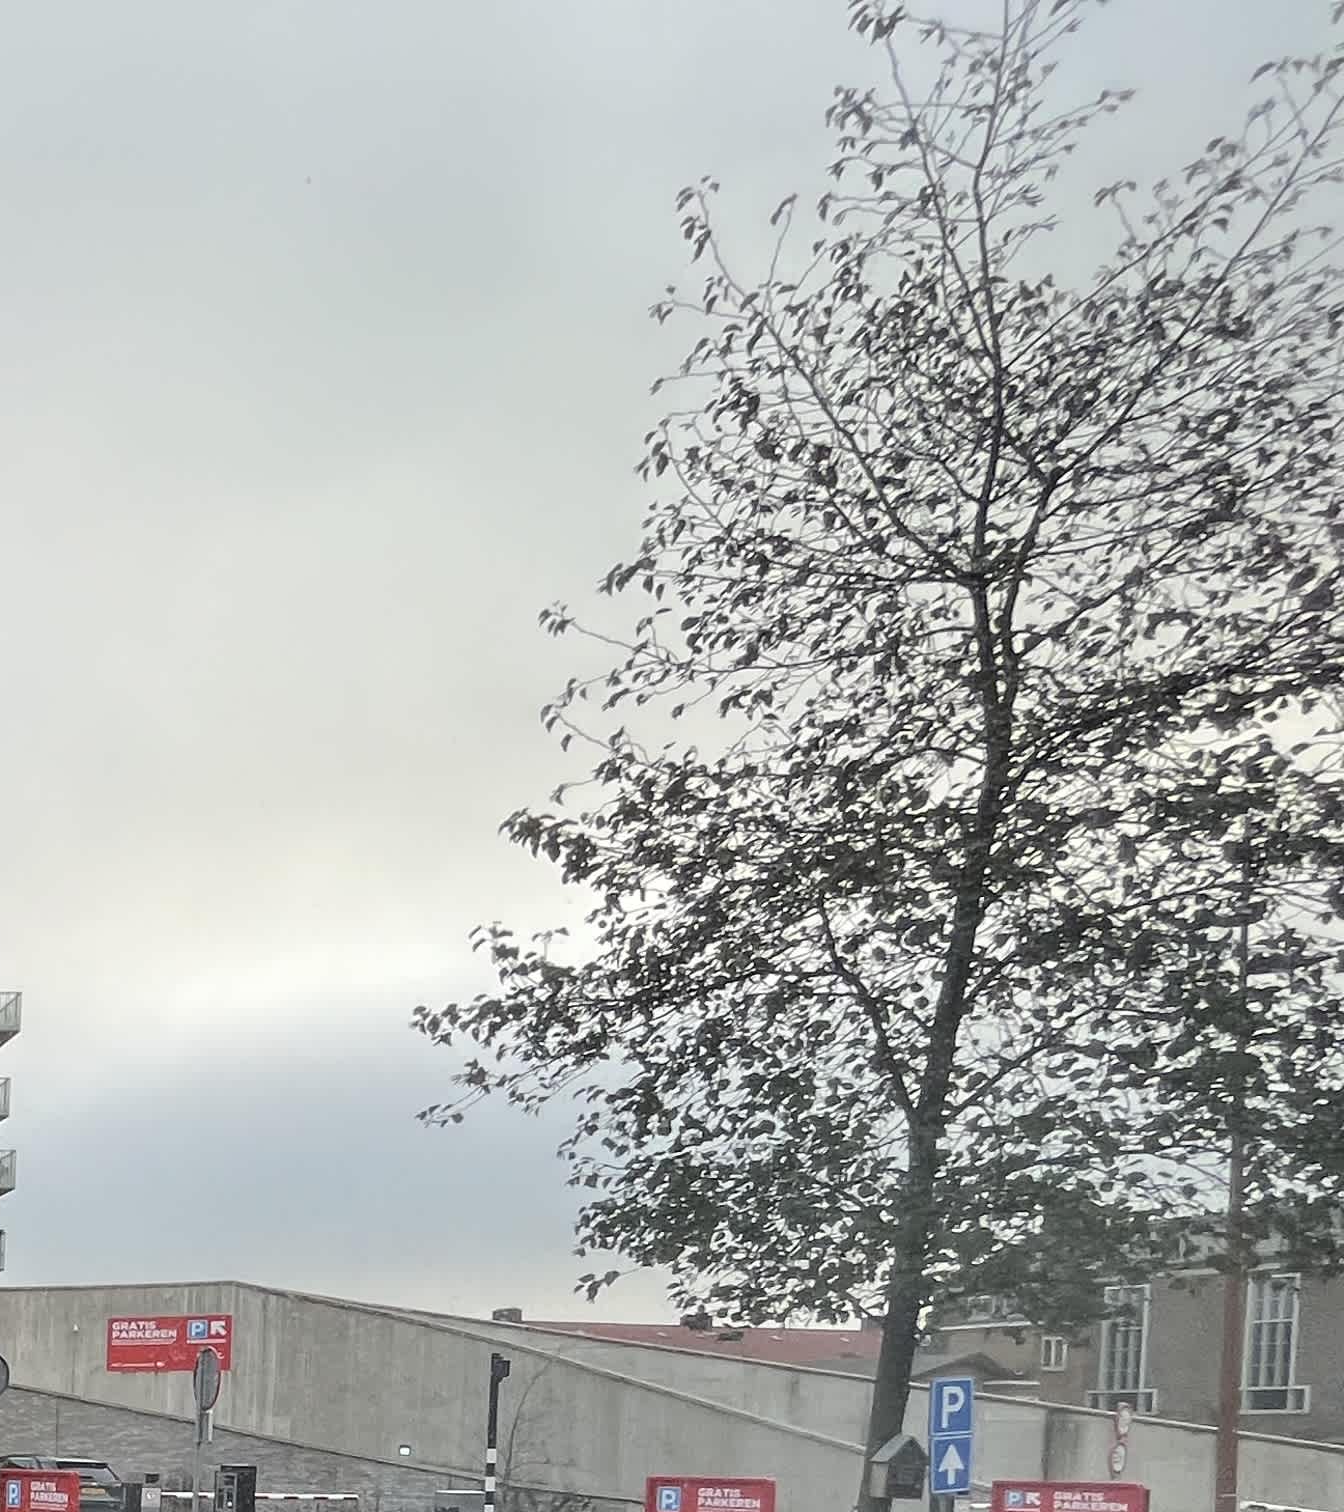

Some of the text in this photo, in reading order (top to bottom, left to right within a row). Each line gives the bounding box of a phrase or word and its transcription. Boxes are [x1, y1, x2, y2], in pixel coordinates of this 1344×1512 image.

[112, 1320, 157, 1331] GRATIS
[111, 1329, 177, 1339] PARKEREN
[941, 1386, 965, 1429] P
[697, 1487, 742, 1498] GRATIS
[1053, 1490, 1105, 1502] GRATIS
[697, 1497, 761, 1509] PARKEREN
[1053, 1500, 1129, 1512] PARKEREN
